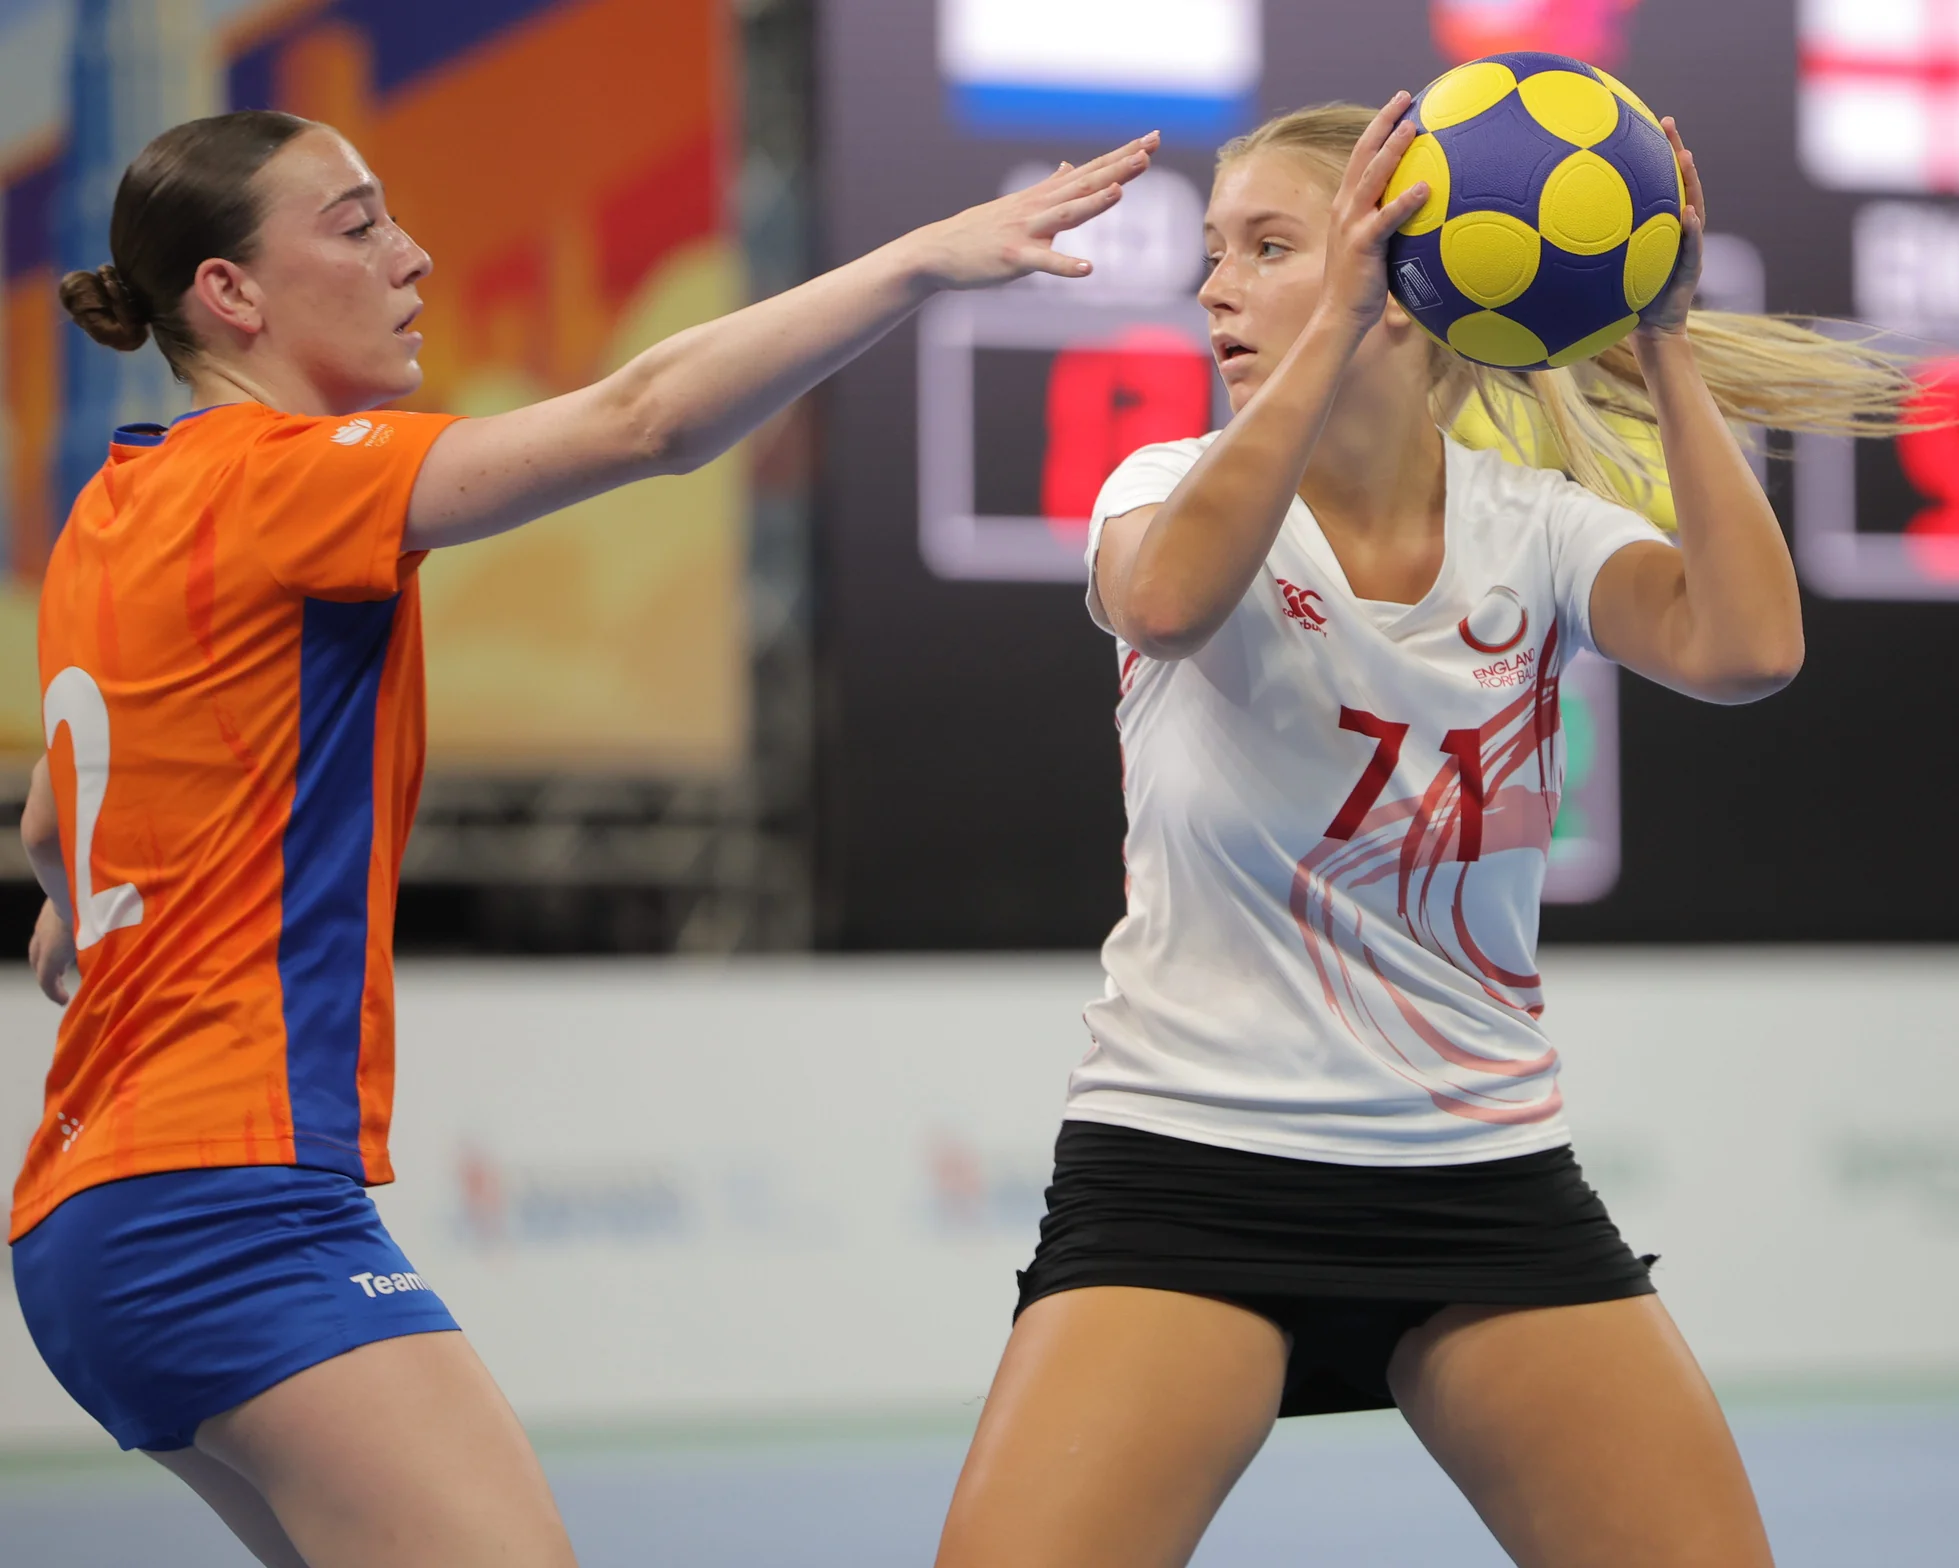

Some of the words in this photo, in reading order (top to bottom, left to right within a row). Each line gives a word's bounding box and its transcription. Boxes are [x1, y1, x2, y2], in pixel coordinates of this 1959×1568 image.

[1472, 647, 1535, 680] ENGLAND
[1478, 663, 1537, 689] KORFBALL
[1323, 704, 1484, 862] 71
[350, 1271, 433, 1299] Team
